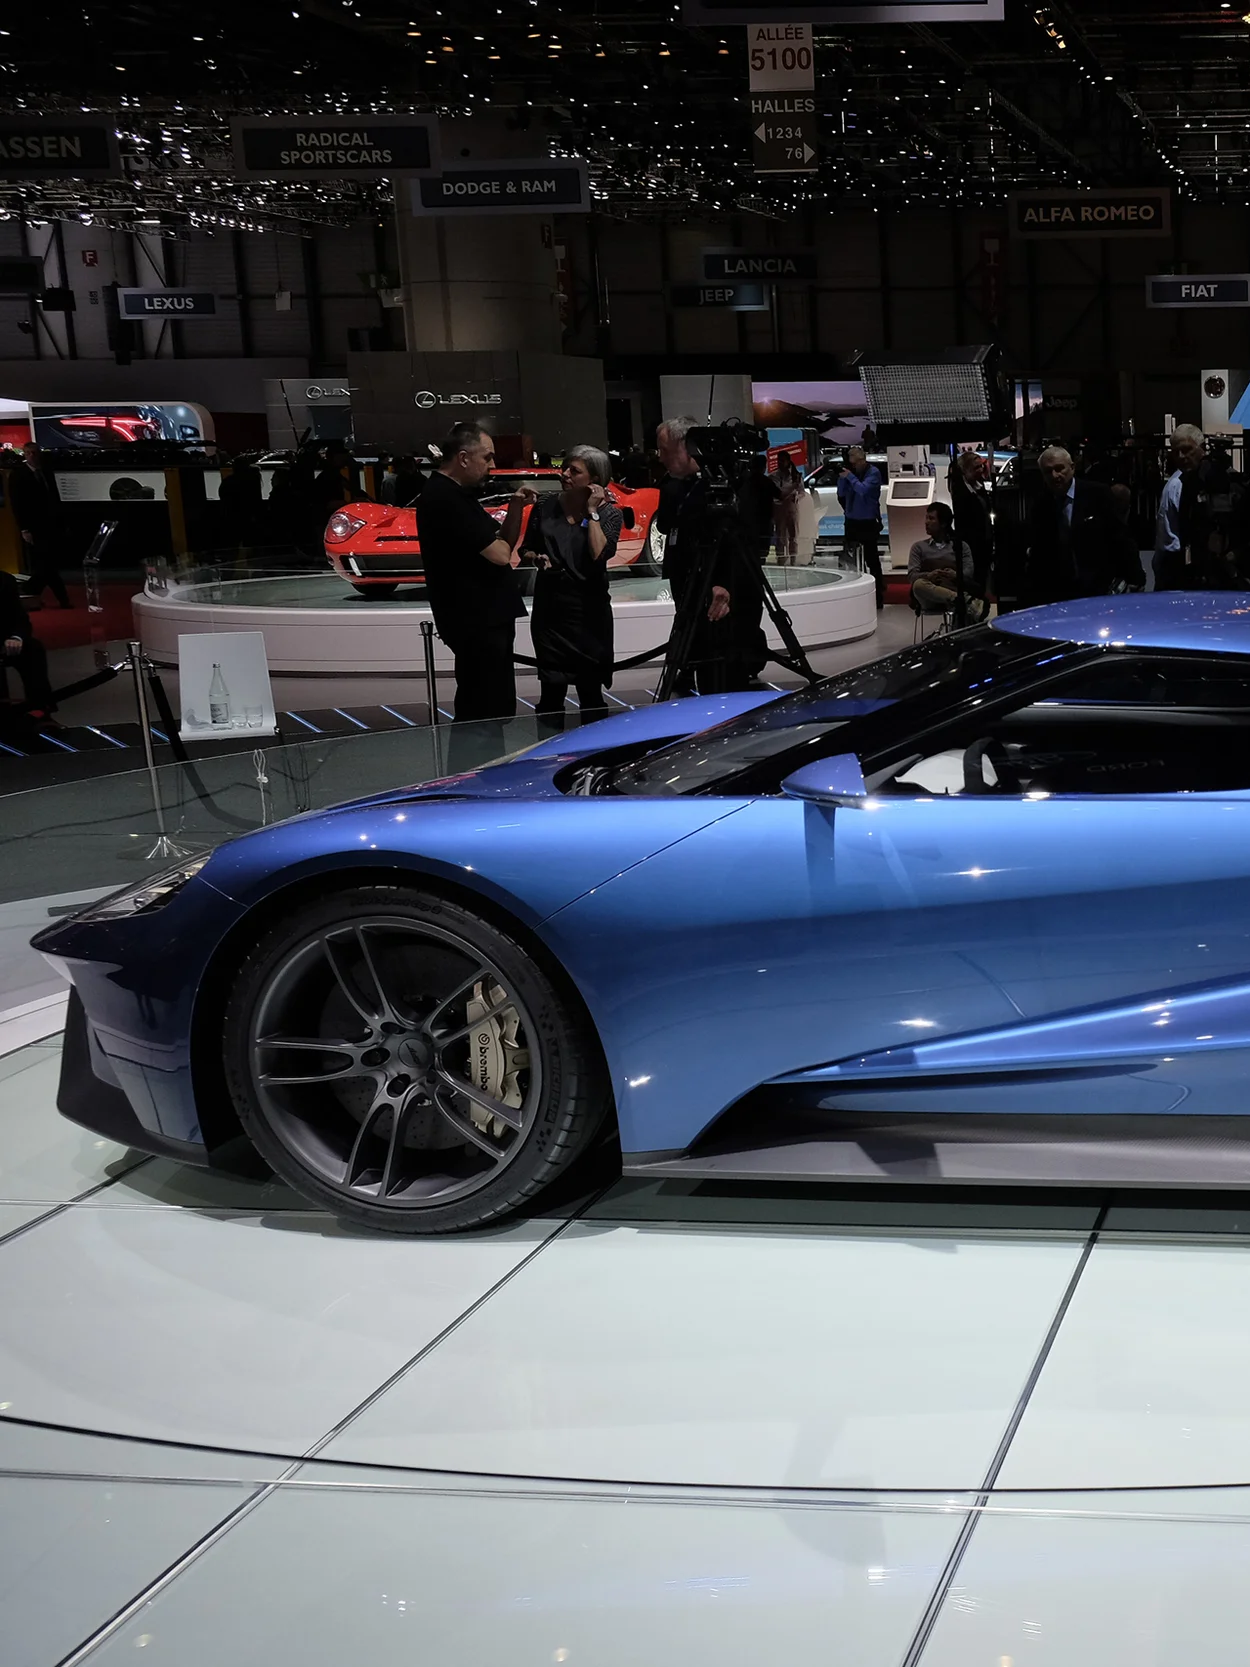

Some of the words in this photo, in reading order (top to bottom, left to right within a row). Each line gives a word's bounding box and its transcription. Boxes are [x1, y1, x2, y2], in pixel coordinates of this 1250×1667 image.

[756, 25, 804, 41] ALLÉE
[750, 46, 812, 71] 5100
[751, 98, 816, 114] HALLES
[295, 132, 374, 148] RADICAL
[280, 149, 393, 165] SPORTSCARS
[784, 147, 803, 160] 76
[442, 181, 502, 196] DODGE
[505, 181, 518, 195] &
[521, 180, 557, 194] RAM
[1023, 206, 1076, 224] ALFA
[1080, 204, 1156, 222] ROMEO
[723, 258, 798, 275] LANCIA
[699, 288, 735, 304] JEEP
[1180, 283, 1219, 299] FIAT
[144, 297, 195, 310] LEXUS
[437, 394, 503, 405] LEXUS
[1045, 395, 1078, 410] Jeep
[478, 1046, 490, 1091] brembo
